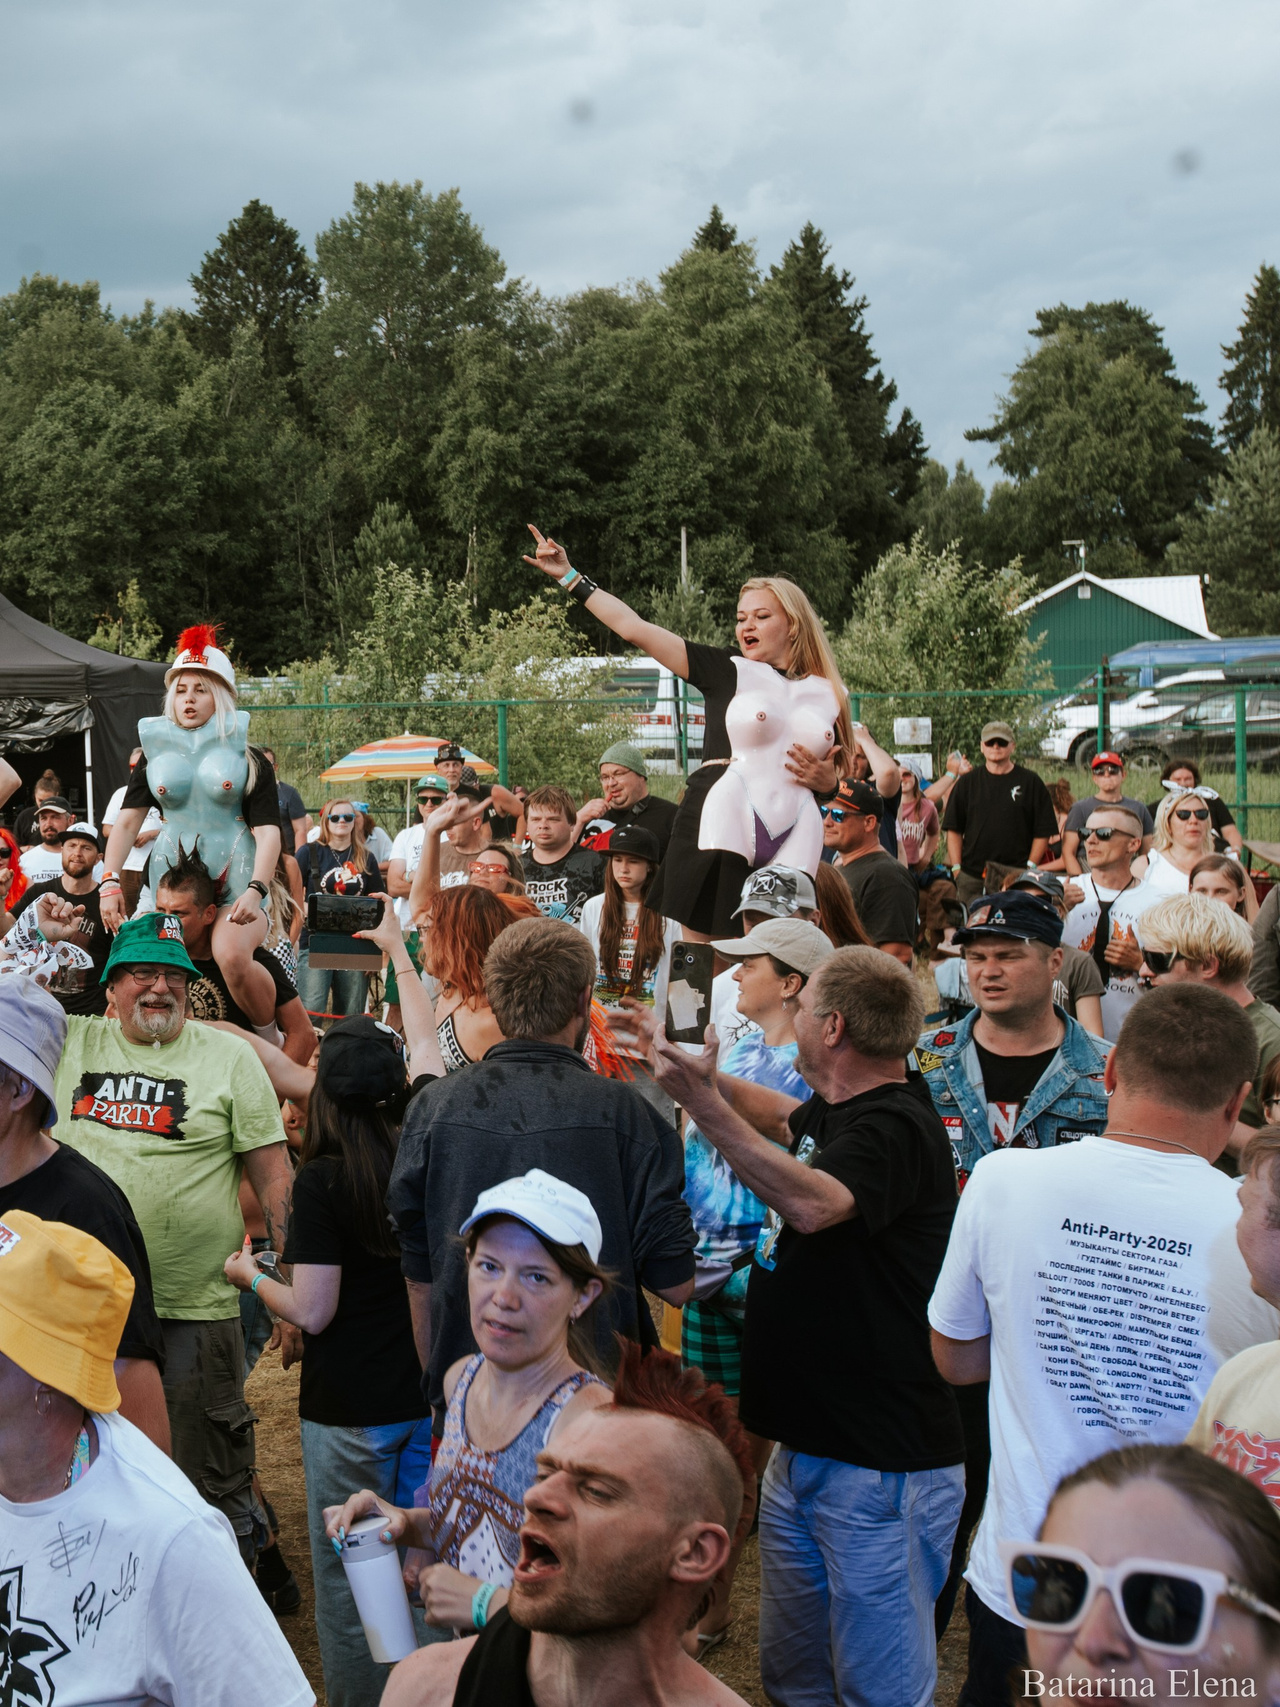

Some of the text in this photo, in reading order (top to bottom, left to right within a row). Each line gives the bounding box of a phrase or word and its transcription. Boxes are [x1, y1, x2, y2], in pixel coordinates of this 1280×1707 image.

[527, 880, 567, 895] ROCK
[1082, 911, 1139, 923] FUKIN
[94, 1076, 174, 1102] ANTI-
[88, 1099, 161, 1126] PARTY
[1060, 1131, 1096, 1140] СПЕЦОТ
[1061, 1218, 1193, 1257] Anti-Party-2025!
[1070, 1239, 1178, 1268] МУЗЫКАНТЫ СЕКТОРА ГАЗА
[1080, 1254, 1165, 1278] ГУДТАЙМС БИРТМАН
[1037, 1271, 1068, 1283] SELLOUT
[1049, 1261, 1096, 1275] ПОСЛЕДНИЕ
[1097, 1270, 1123, 1280] ТАНКИ
[1132, 1277, 1165, 1291] ПАРИЖЕ
[1171, 1286, 1194, 1296] Б.А.У.
[1077, 1291, 1112, 1303] МЕНЯЮТ
[1113, 1297, 1133, 1308] ЦВЕТ
[1170, 1312, 1196, 1323] ВЕТЕР
[1101, 1283, 1206, 1313] ПОТОМУЧТО АНГЕЛНЕБЕС
[1077, 1315, 1122, 1329] МИКРОФОН!
[1127, 1325, 1169, 1341] МАМУЛЬКИ
[1170, 1336, 1193, 1347] БЕНД
[1093, 1306, 1124, 1318] ОБЕ-РЕК
[1130, 1312, 1172, 1330] DISTEMPER
[1178, 1325, 1200, 1336] СМЕХ
[1036, 1319, 1055, 1327] ПОРТ
[1112, 1333, 1152, 1347] ADDICTED!
[1156, 1344, 1202, 1360] АБЕРРАЦИЯ
[1039, 1343, 1058, 1351] САНЯ
[1101, 1357, 1137, 1367] СВОБОДА
[1139, 1363, 1171, 1375] ВАЖНЕЕ
[1048, 1357, 1068, 1365] КОНИ
[1106, 1369, 1147, 1381] LONGLONG
[1090, 1343, 1111, 1351] ДЕНЬ
[1115, 1346, 1139, 1356] ПЛЯЖ
[1177, 1361, 1198, 1371] АЗОН
[1045, 1366, 1068, 1377] SOUTH
[1115, 1382, 1142, 1391] ANDY?!
[1148, 1386, 1163, 1397] THE
[1164, 1391, 1192, 1401] SLURM
[1070, 1382, 1090, 1390] DAWN
[1145, 1398, 1186, 1412] БЕШЕНЫЕ
[1132, 1406, 1163, 1418] ПОФИГУ
